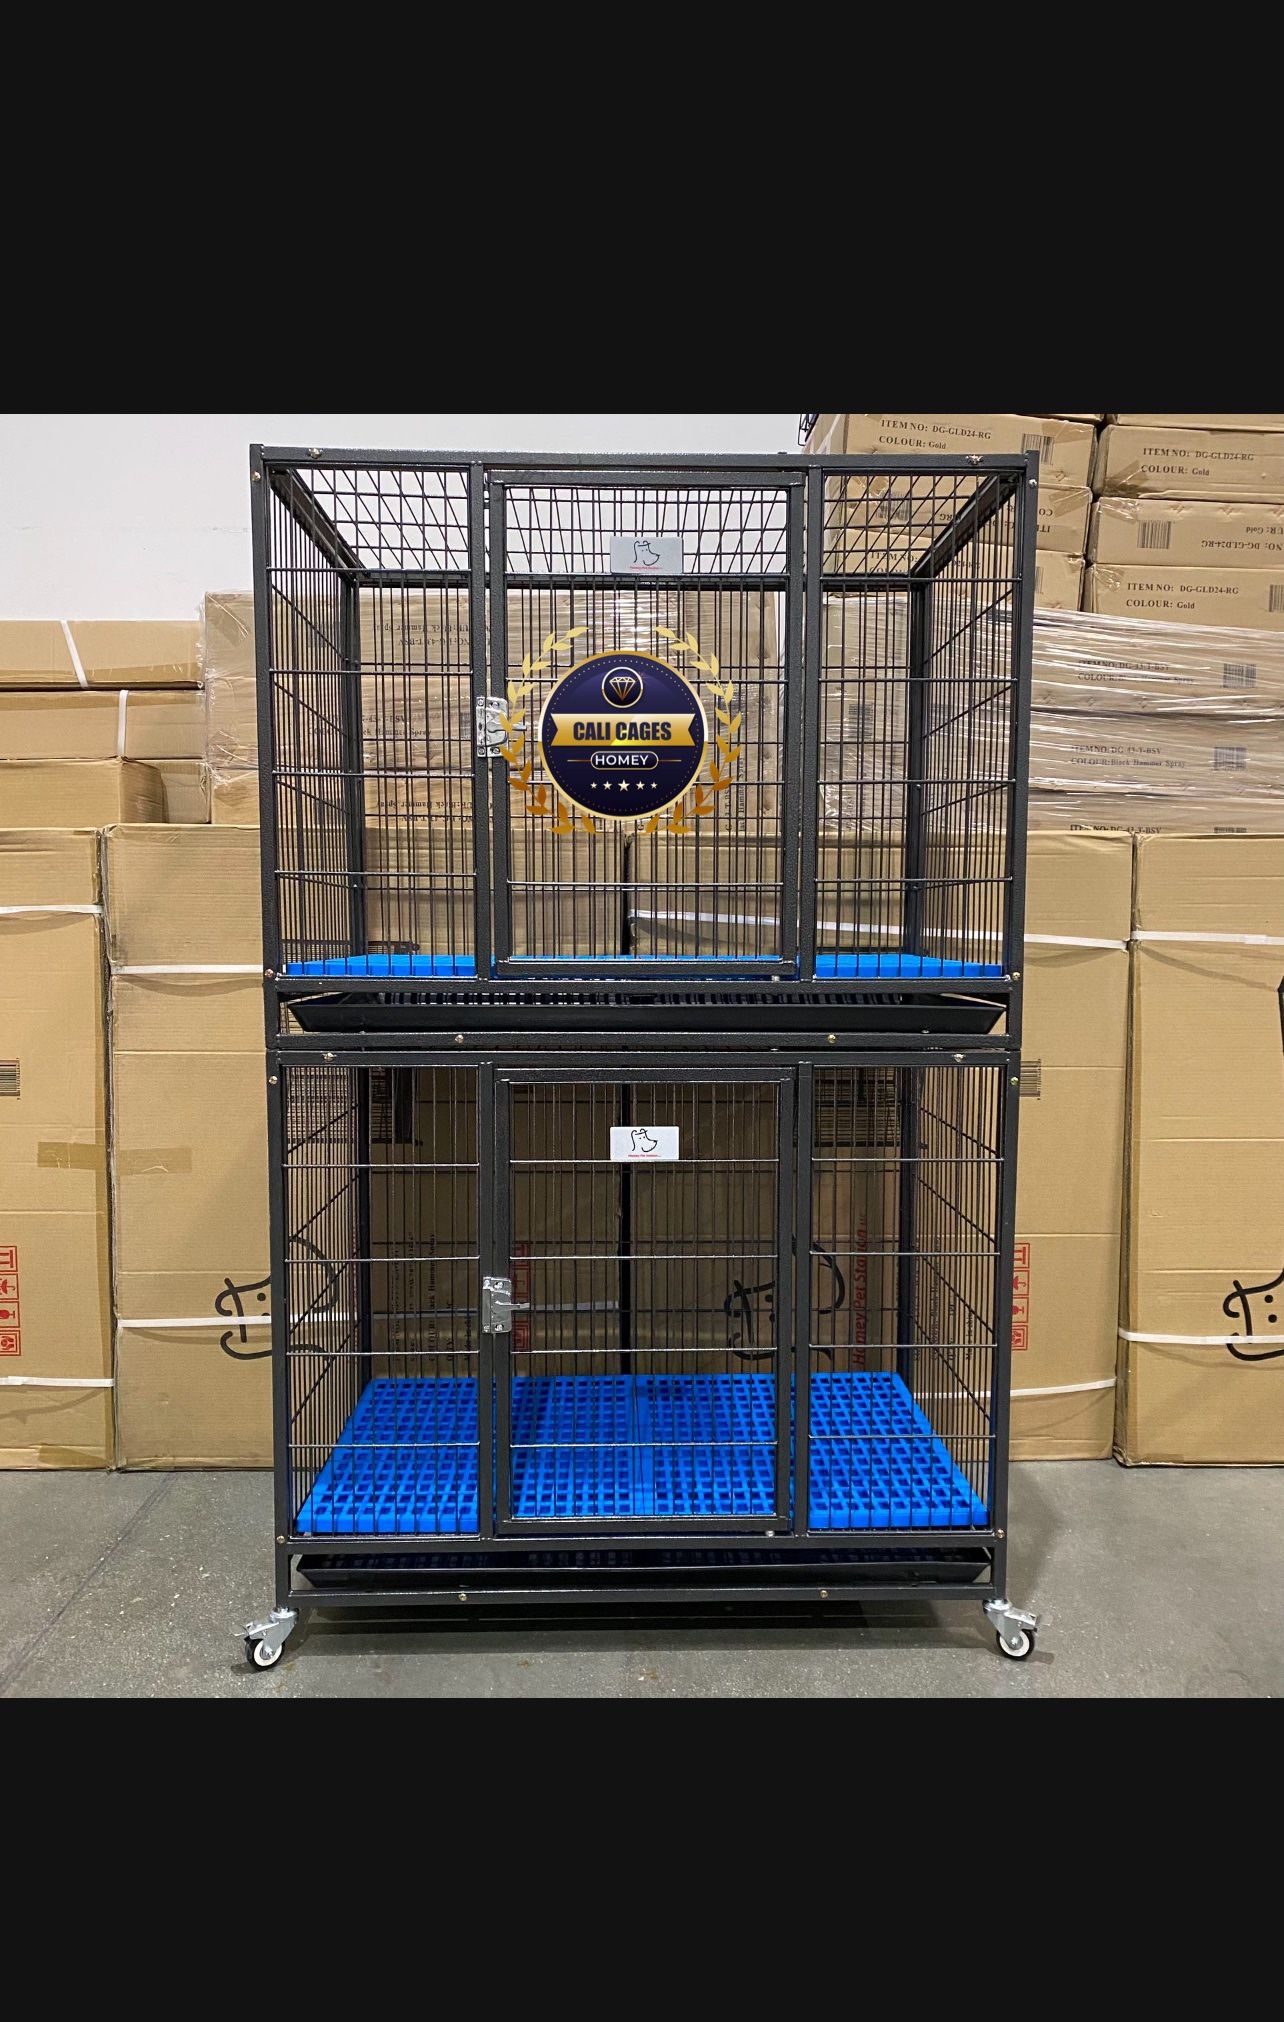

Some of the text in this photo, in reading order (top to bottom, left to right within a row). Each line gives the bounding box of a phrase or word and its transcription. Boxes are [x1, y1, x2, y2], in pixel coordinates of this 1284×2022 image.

[881, 419, 992, 440] ITEM NO: DG-GLD24-RG
[879, 435, 947, 450] COLOUR: Gold
[1143, 447, 1170, 457] ITEM
[1172, 448, 1190, 458] NO:
[1140, 464, 1210, 476] COLOUR: Gold
[1127, 582, 1240, 594] ITEM NO: DG-GLD24-RG
[1126, 599, 1195, 609] COLOUR: Gold
[854, 1229, 867, 1282] Staion
